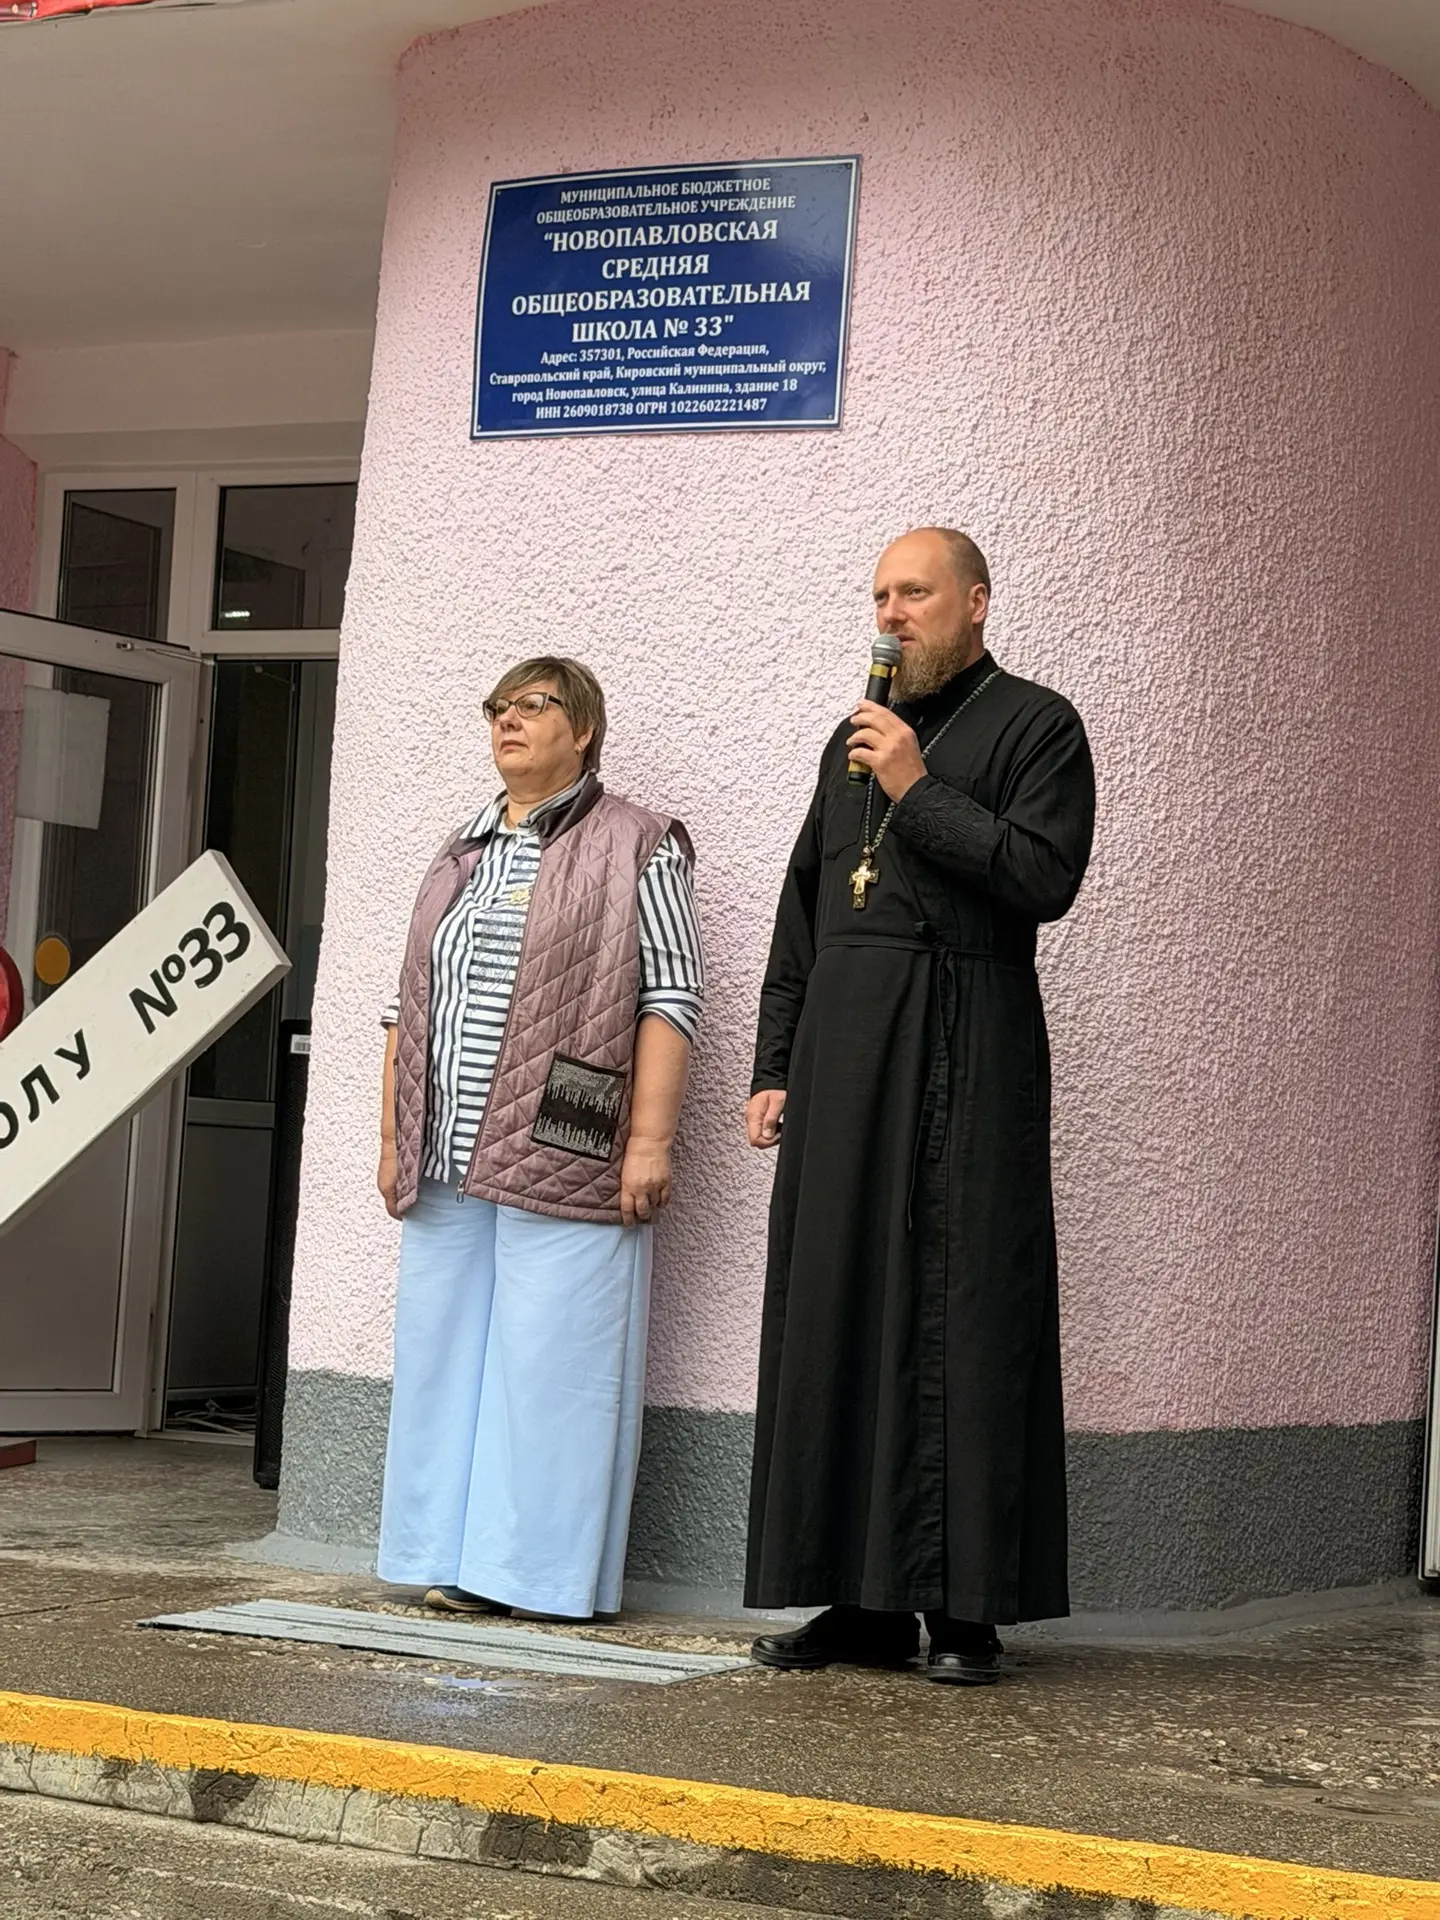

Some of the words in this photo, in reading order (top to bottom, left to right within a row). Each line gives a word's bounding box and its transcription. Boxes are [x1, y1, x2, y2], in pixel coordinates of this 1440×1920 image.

[560, 182, 679, 204] МУНИЦИПАЛЬНОЕ
[681, 178, 771, 196] БЮДЖЕТНОЕ
[536, 200, 698, 225] ОБЩЕОБРАЗОВАТЕЛЬНОЕ
[700, 195, 797, 213] УЧРЕЖДЕНИЕ
[601, 254, 710, 282] СРЕДНЯЯ
[511, 281, 811, 317] ОБЩЕОБРАЗОВАТЕЛЬНАЯ
[571, 319, 658, 343] ШКОЛА
[663, 317, 689, 338] №
[540, 351, 577, 366] Адрес:
[579, 349, 625, 363] 357301,
[626, 345, 695, 361] Российская
[697, 343, 770, 359] Федерация,
[489, 369, 580, 387] Ставропольский
[582, 367, 613, 383] край,
[615, 362, 681, 380] Кировский
[683, 360, 786, 379] муниципальный
[788, 360, 827, 374] округ,
[512, 389, 544, 404] город
[545, 386, 630, 402] Новопавловск,
[631, 384, 667, 399] улица
[668, 381, 733, 396] Калинина,
[734, 381, 779, 394] здание
[782, 378, 798, 392] 18
[535, 406, 561, 420] ИНН
[563, 403, 633, 418] 2609018738
[635, 401, 667, 415] ОГРН
[670, 398, 768, 414] 1022602221487
